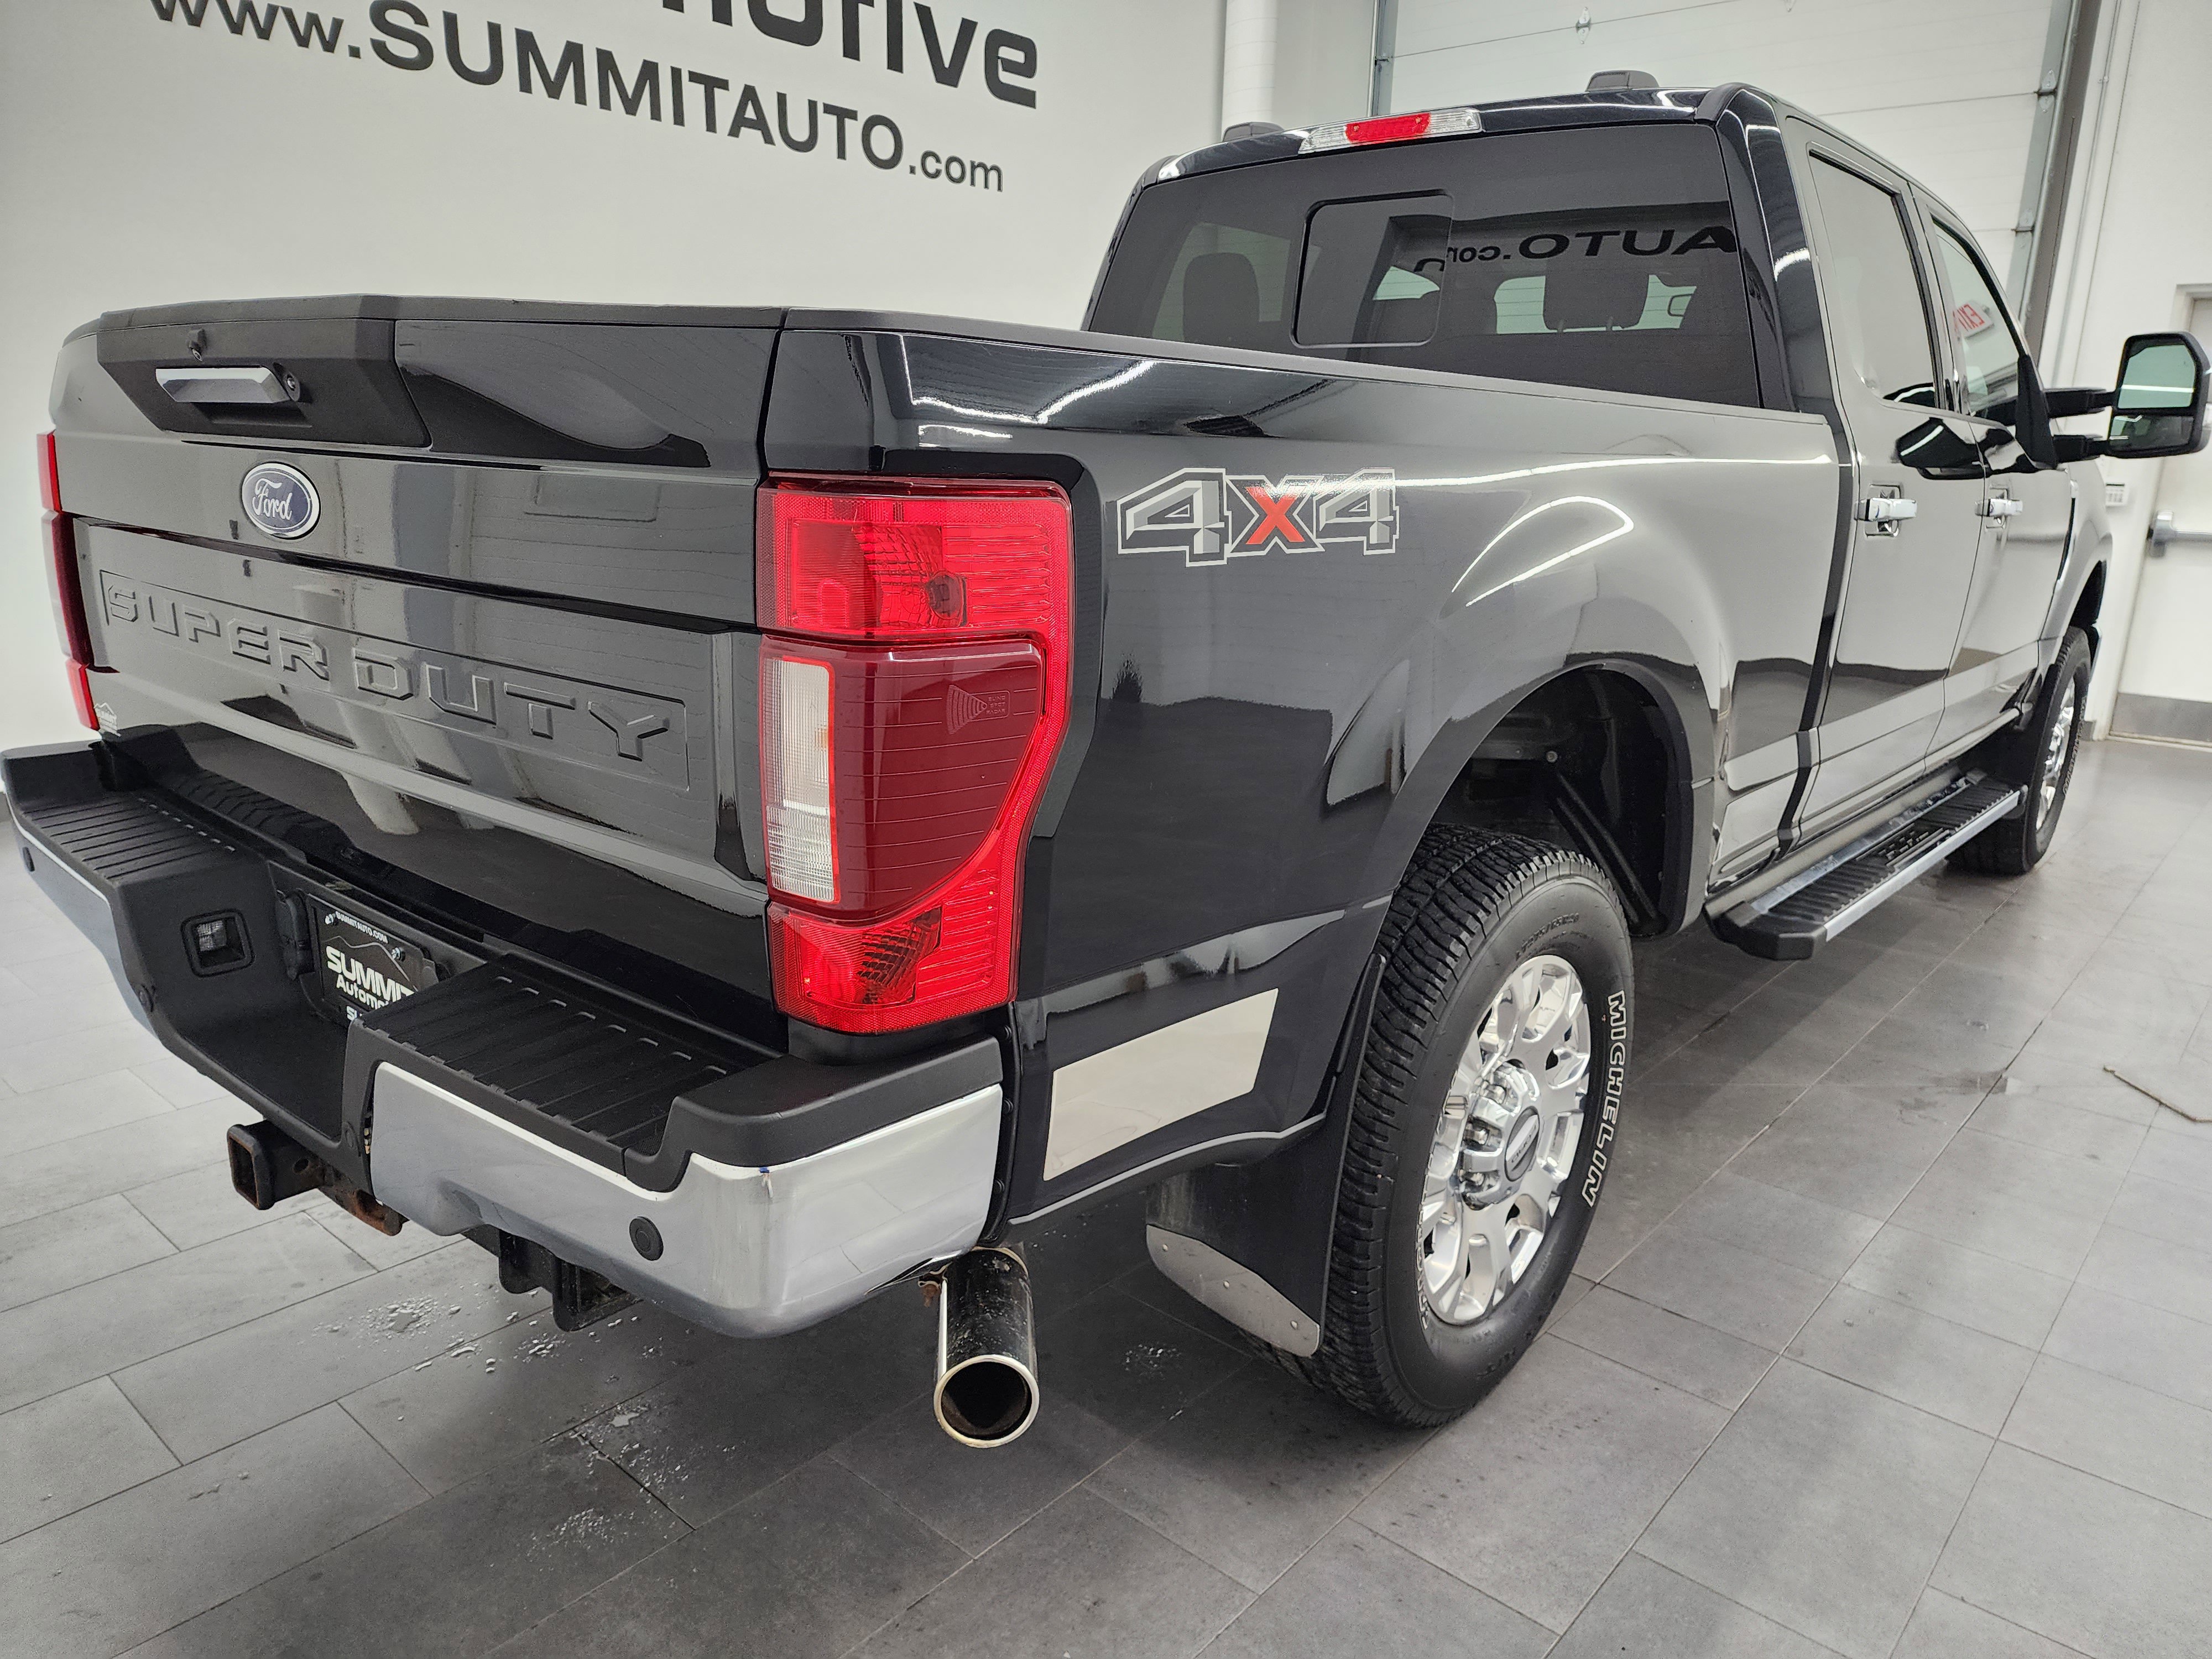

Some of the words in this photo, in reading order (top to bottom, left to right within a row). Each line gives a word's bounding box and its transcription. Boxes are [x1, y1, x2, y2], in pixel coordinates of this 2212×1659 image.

[663, 0, 1036, 109] otive
[252, 478, 293, 520] Ford
[109, 583, 328, 680] SUPER
[354, 649, 668, 760] DUTY
[1582, 990, 1626, 1207] MICHELIN
